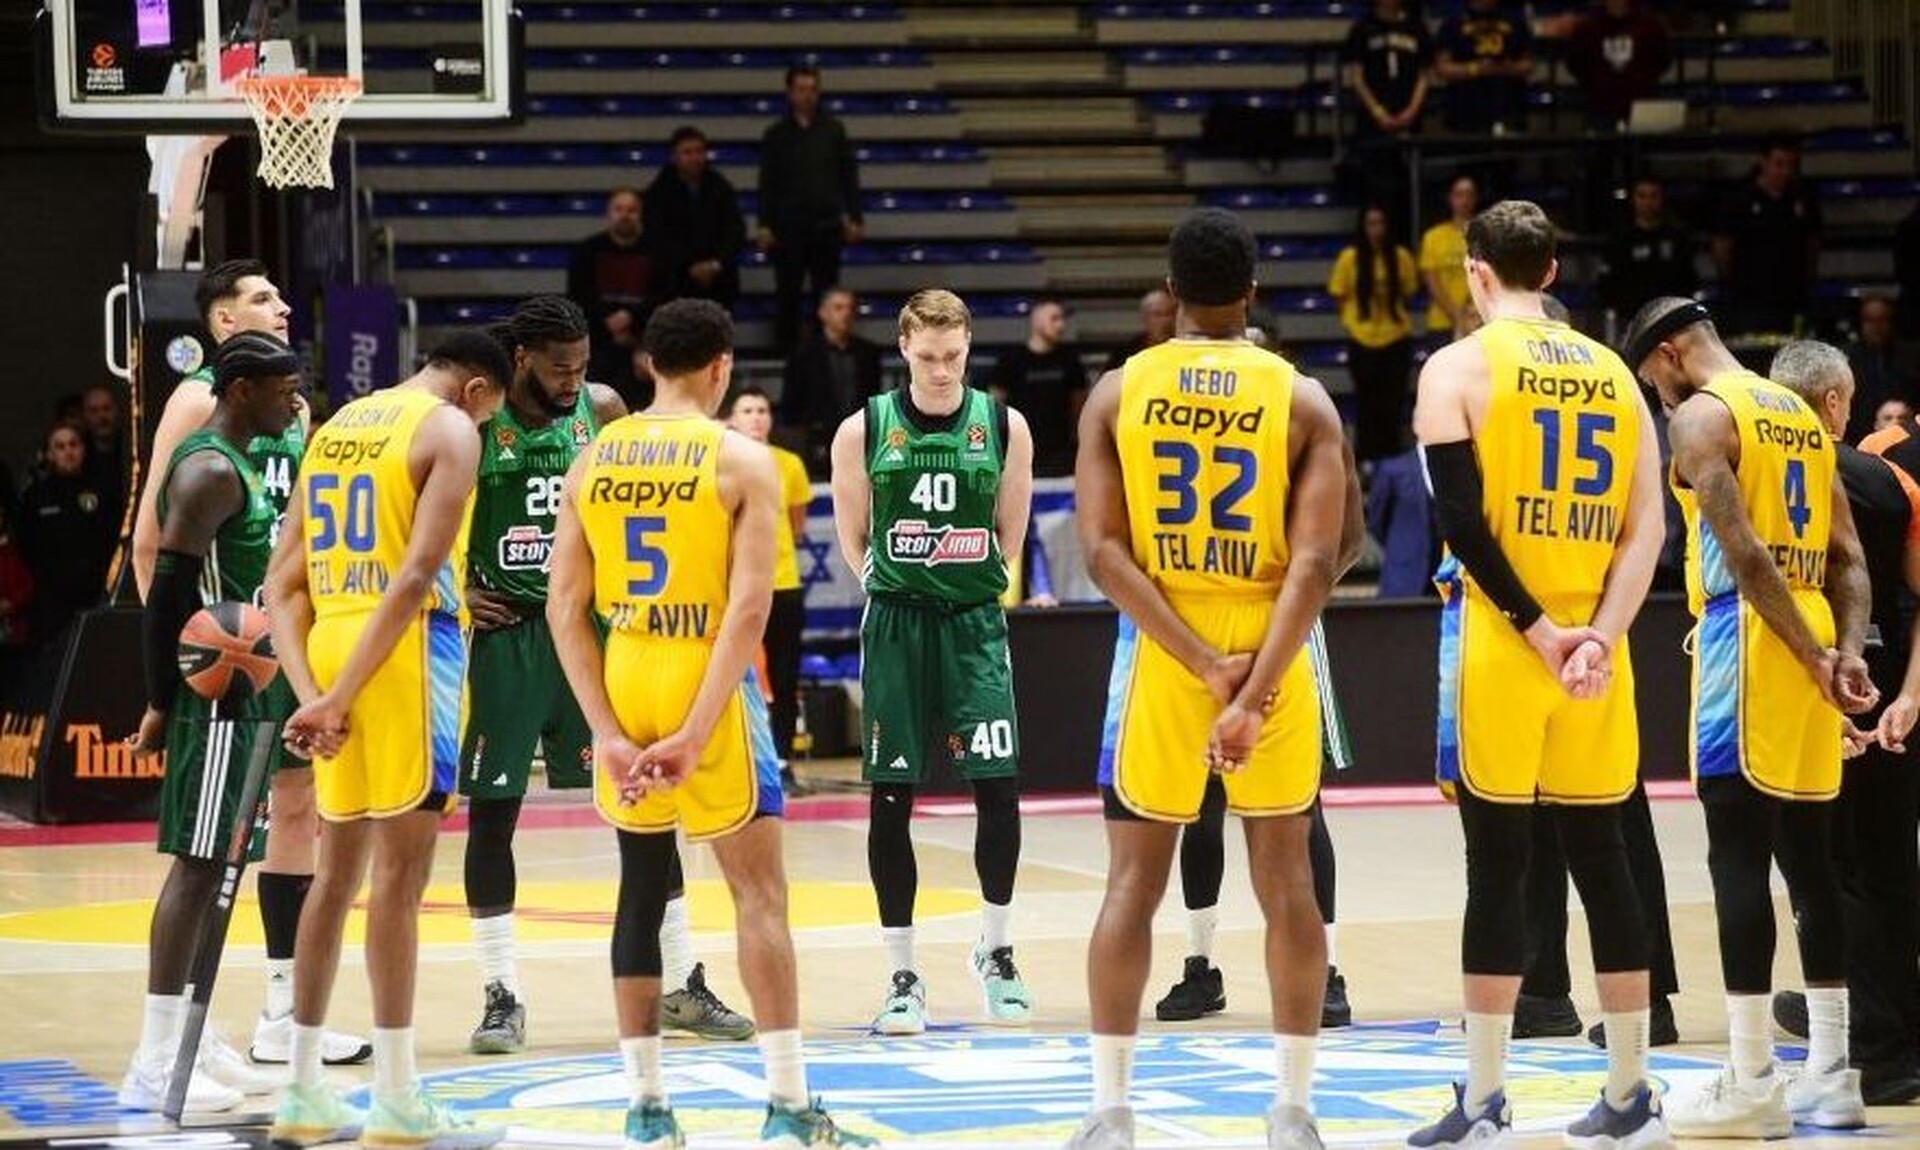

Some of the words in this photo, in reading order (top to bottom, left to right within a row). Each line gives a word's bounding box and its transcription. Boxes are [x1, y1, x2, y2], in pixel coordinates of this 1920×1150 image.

[346, 333, 377, 398] Rap
[1527, 340, 1594, 365] COHEN
[1180, 368, 1236, 397] NEBO
[1518, 367, 1616, 404] Rapyd
[1144, 398, 1264, 437] Rapyd
[1755, 418, 1823, 453] Rapyd
[1533, 409, 1615, 496] 15
[265, 457, 291, 497] 44
[590, 475, 699, 508] Rapyd
[909, 472, 957, 511] 40
[1153, 440, 1258, 532] 32
[308, 474, 376, 552] 50
[1516, 496, 1557, 537] TEL
[1566, 502, 1618, 543] AVIV
[1784, 459, 1812, 540] 4
[625, 516, 668, 595] 5
[1154, 533, 1196, 571] TEL
[1203, 536, 1257, 577] AVIV
[648, 603, 708, 637] AVIV
[970, 719, 1013, 760] 40
